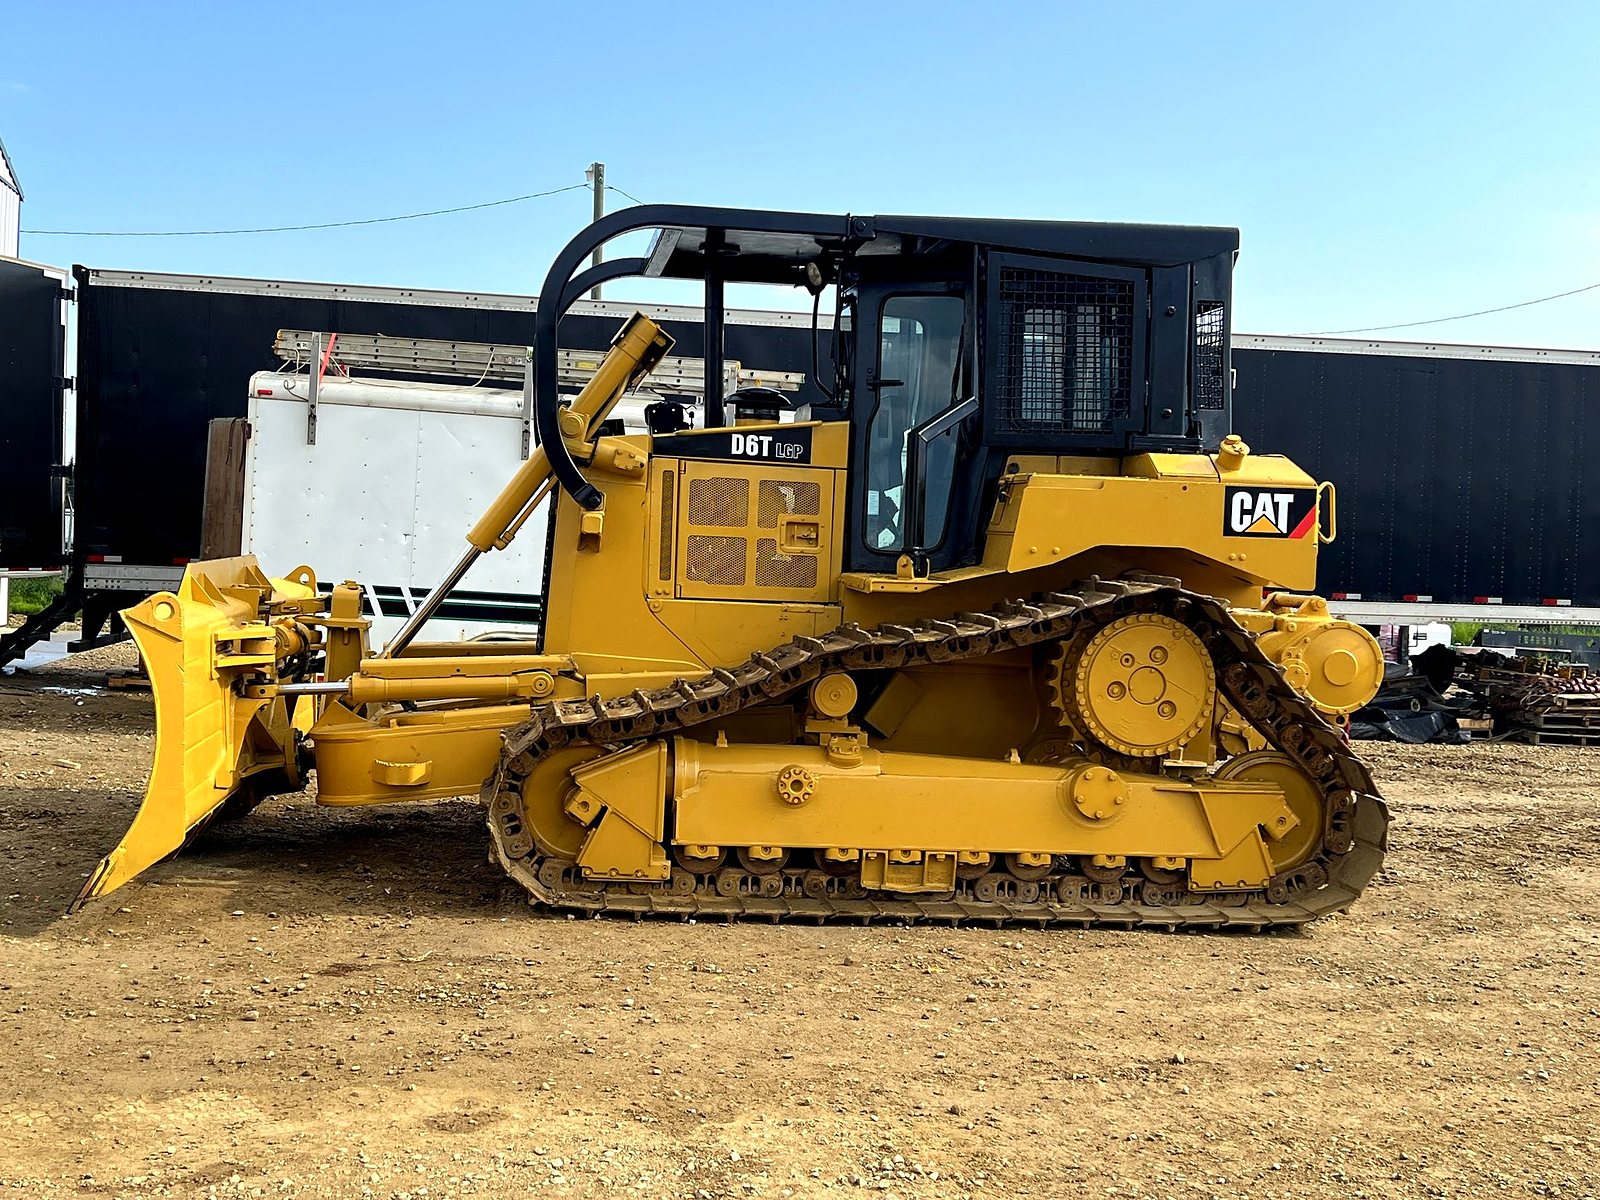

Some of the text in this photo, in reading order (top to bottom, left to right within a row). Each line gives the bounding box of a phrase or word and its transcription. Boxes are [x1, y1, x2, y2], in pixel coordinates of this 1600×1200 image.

[731, 433, 804, 459] D6T LGP
[1230, 491, 1294, 534] CAT
